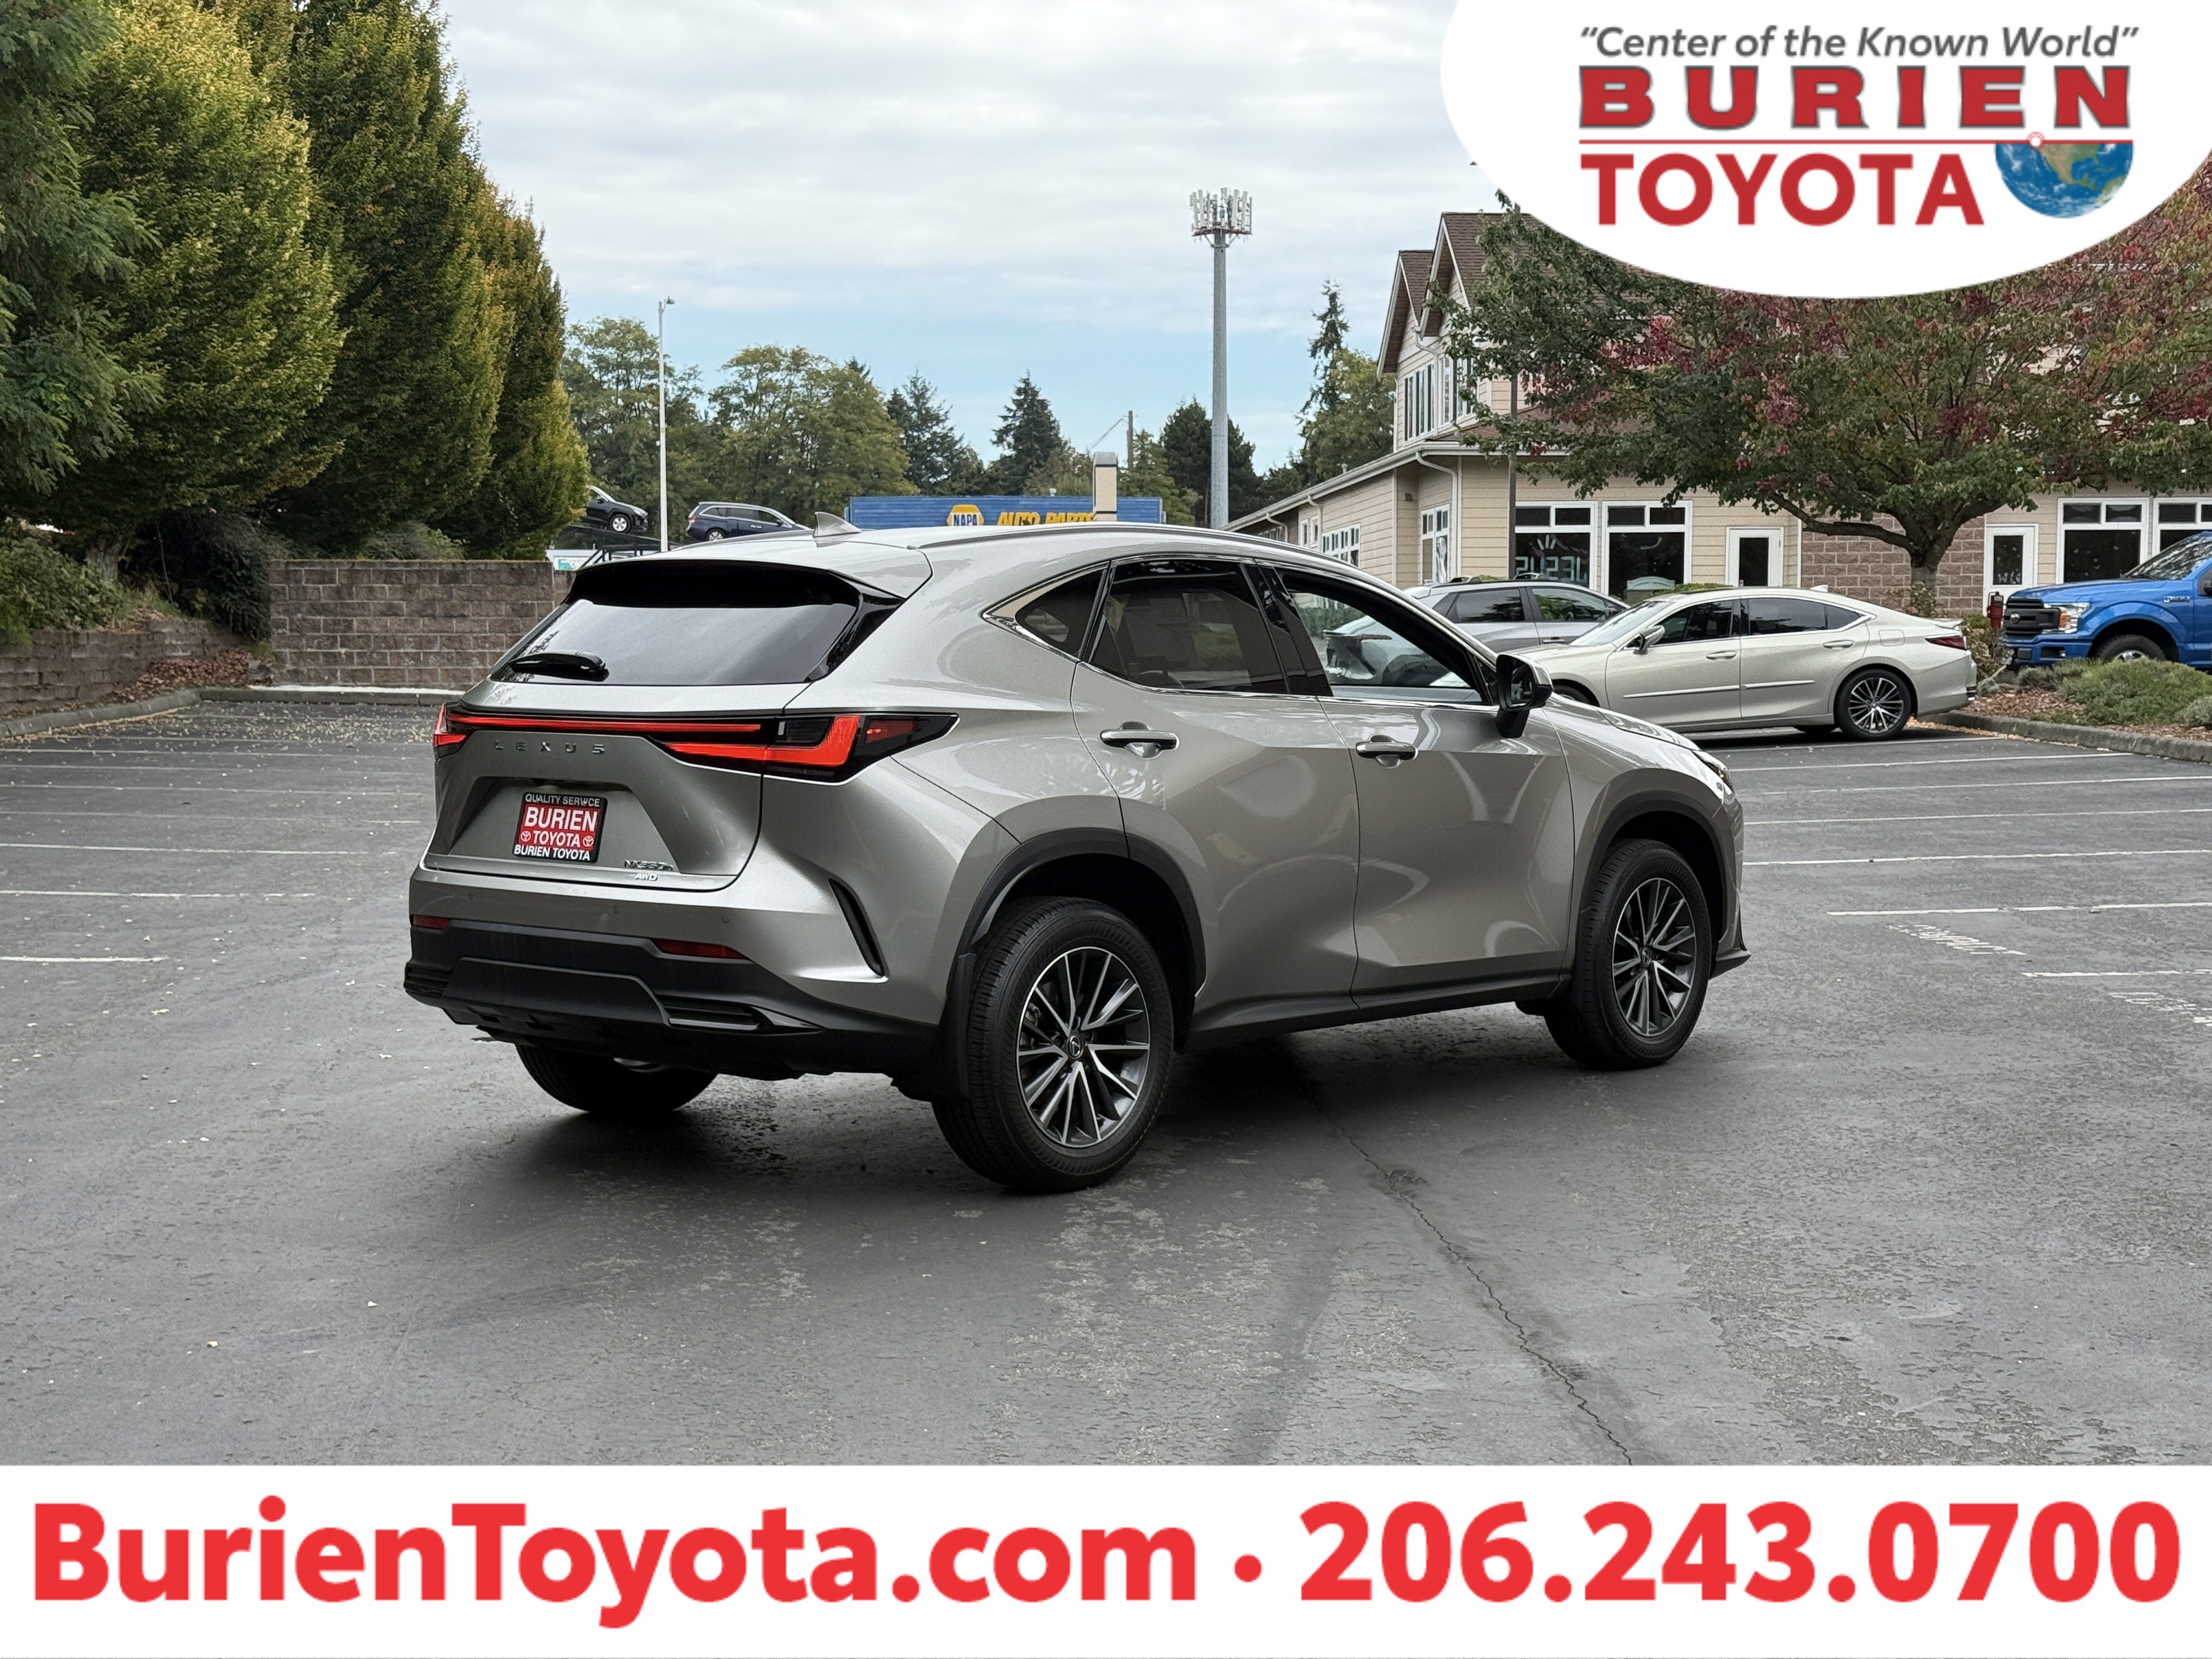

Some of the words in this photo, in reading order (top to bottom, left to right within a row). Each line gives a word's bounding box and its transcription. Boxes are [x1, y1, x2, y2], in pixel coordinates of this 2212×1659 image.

[953, 514, 978, 526] NAPA
[494, 740, 605, 754] LEXUS
[525, 793, 561, 804] QUALITY
[562, 797, 600, 807] SERVICE
[524, 806, 598, 832] BURIEN
[533, 830, 580, 848] TOYOTA
[514, 844, 550, 857] BURIEN
[552, 847, 590, 861] TOYOTA
[635, 873, 658, 882] AWD
